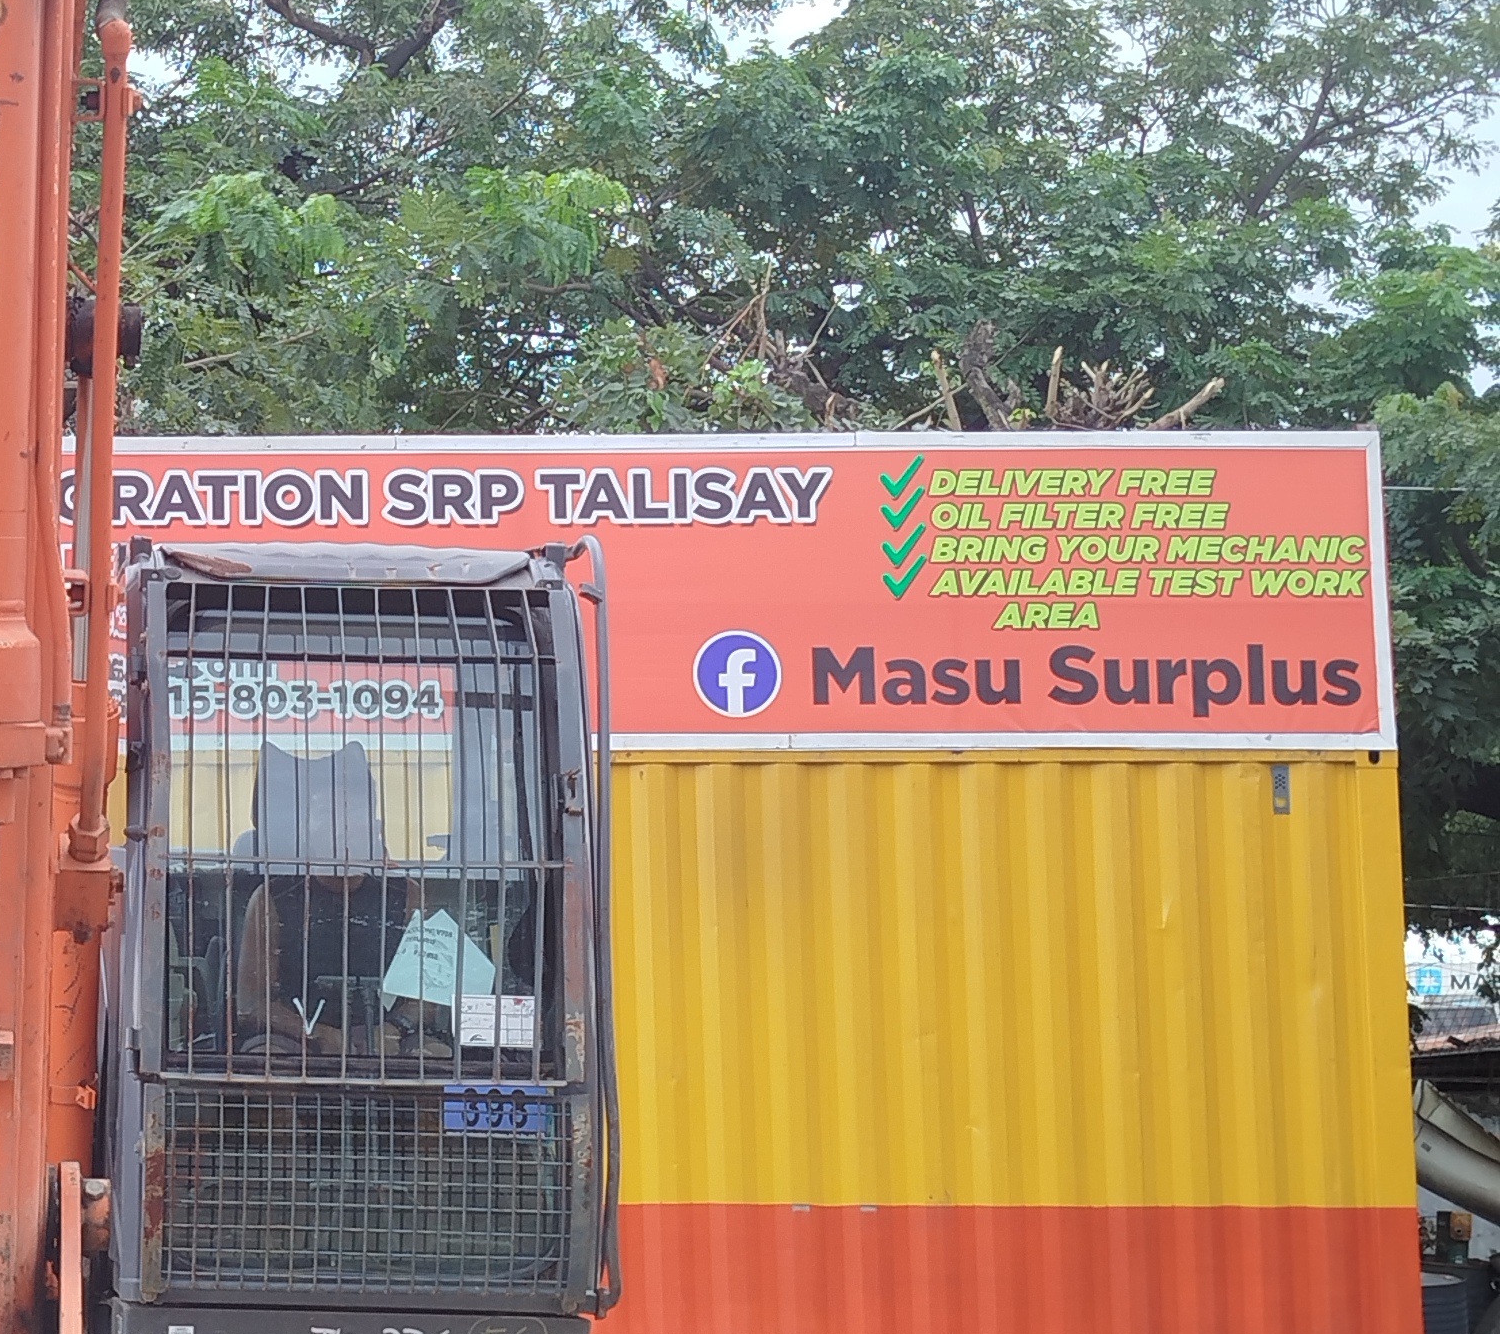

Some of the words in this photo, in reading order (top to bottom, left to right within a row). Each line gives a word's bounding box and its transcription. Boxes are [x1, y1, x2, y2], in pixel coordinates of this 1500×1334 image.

[383, 466, 524, 526] SRP
[534, 466, 833, 526] TALISAY
[928, 469, 1115, 496] DELIVERY
[1117, 469, 1216, 496] FREE
[930, 502, 990, 530] OIL
[998, 502, 1126, 530] FILTER
[1129, 502, 1229, 530] FREE
[930, 535, 1048, 564] BRING
[1056, 535, 1160, 564] YOUR
[1164, 535, 1366, 564] MECHANIC
[928, 569, 1140, 597] AVAILABLE
[1147, 569, 1243, 597] TEST
[1249, 569, 1368, 597] WORK
[993, 601, 1101, 630] AREA
[811, 646, 1021, 706] Masu
[1046, 644, 1362, 717] Surplus
[168, 678, 444, 721] 15-803-1094
